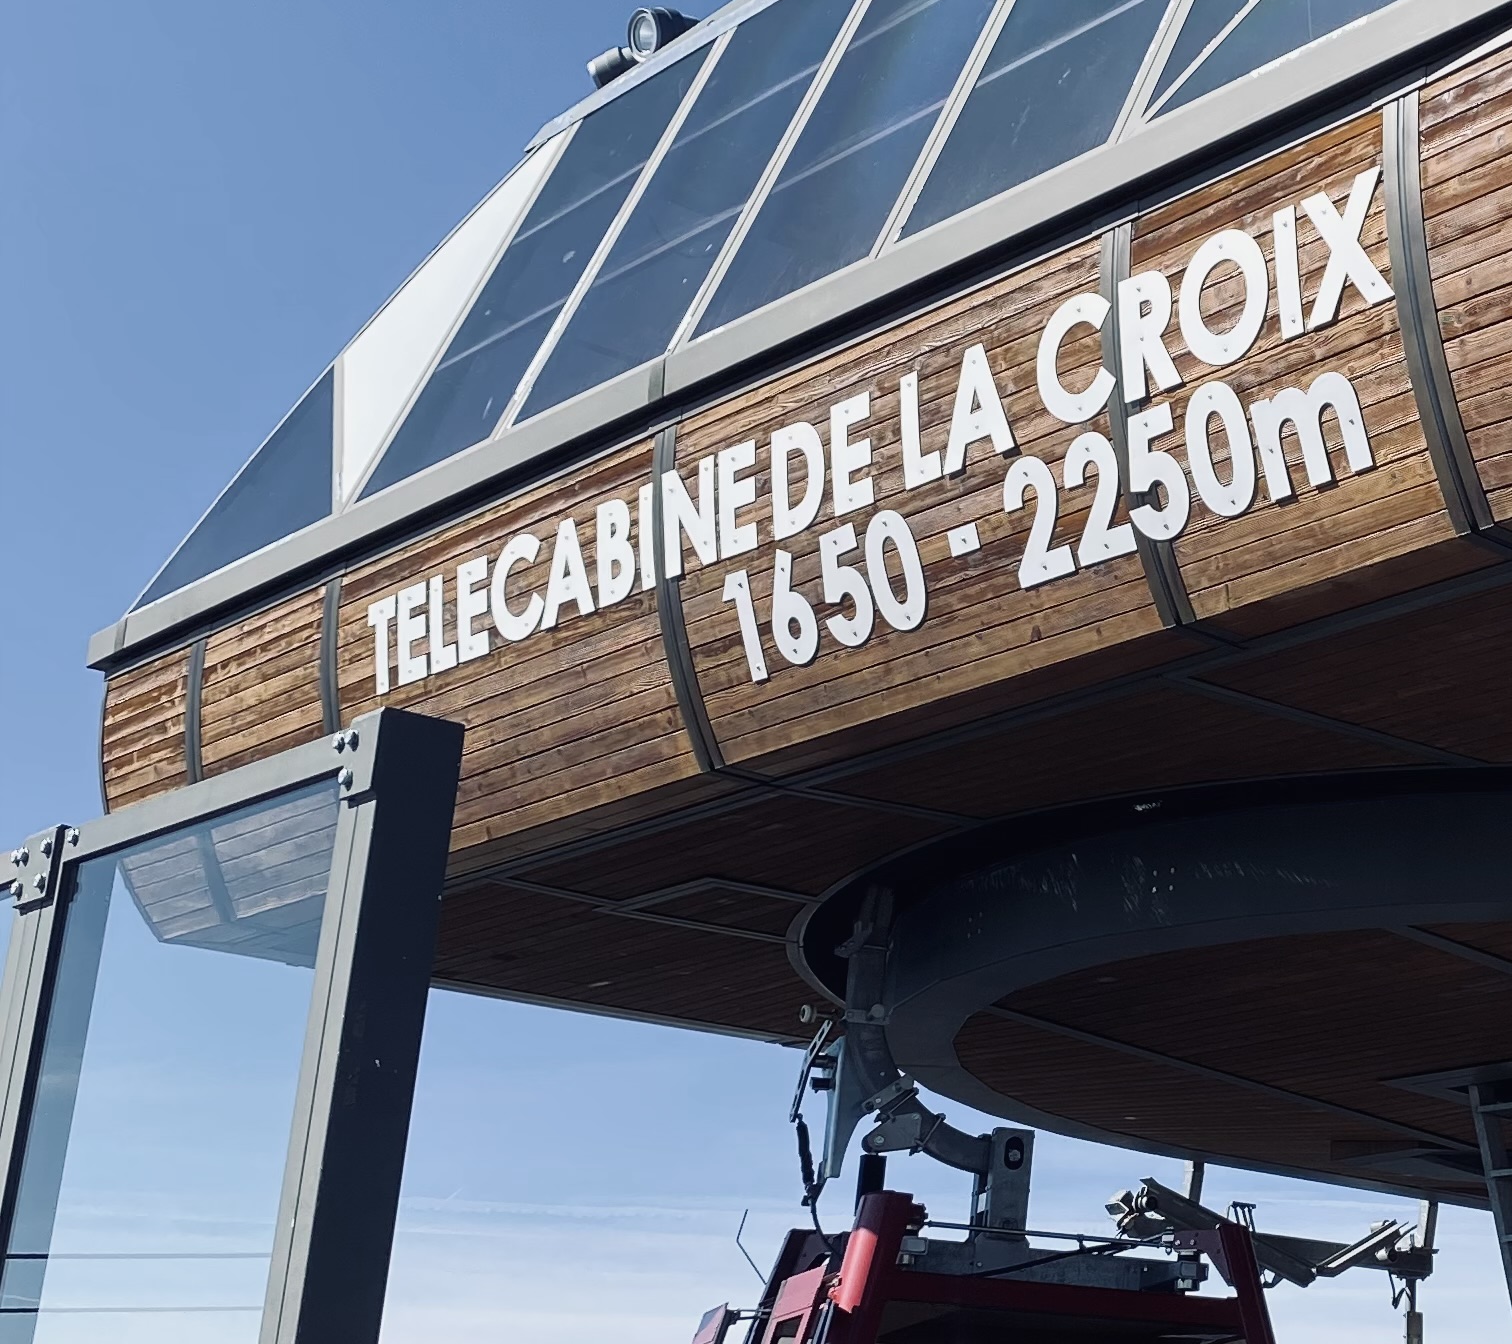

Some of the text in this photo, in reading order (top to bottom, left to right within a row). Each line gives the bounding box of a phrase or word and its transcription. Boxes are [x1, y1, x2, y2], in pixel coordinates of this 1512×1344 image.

[367, 165, 1396, 696] TELECABINE DE LA CROIX
[722, 510, 927, 684] 1650
[1003, 370, 1374, 590] 2250m
